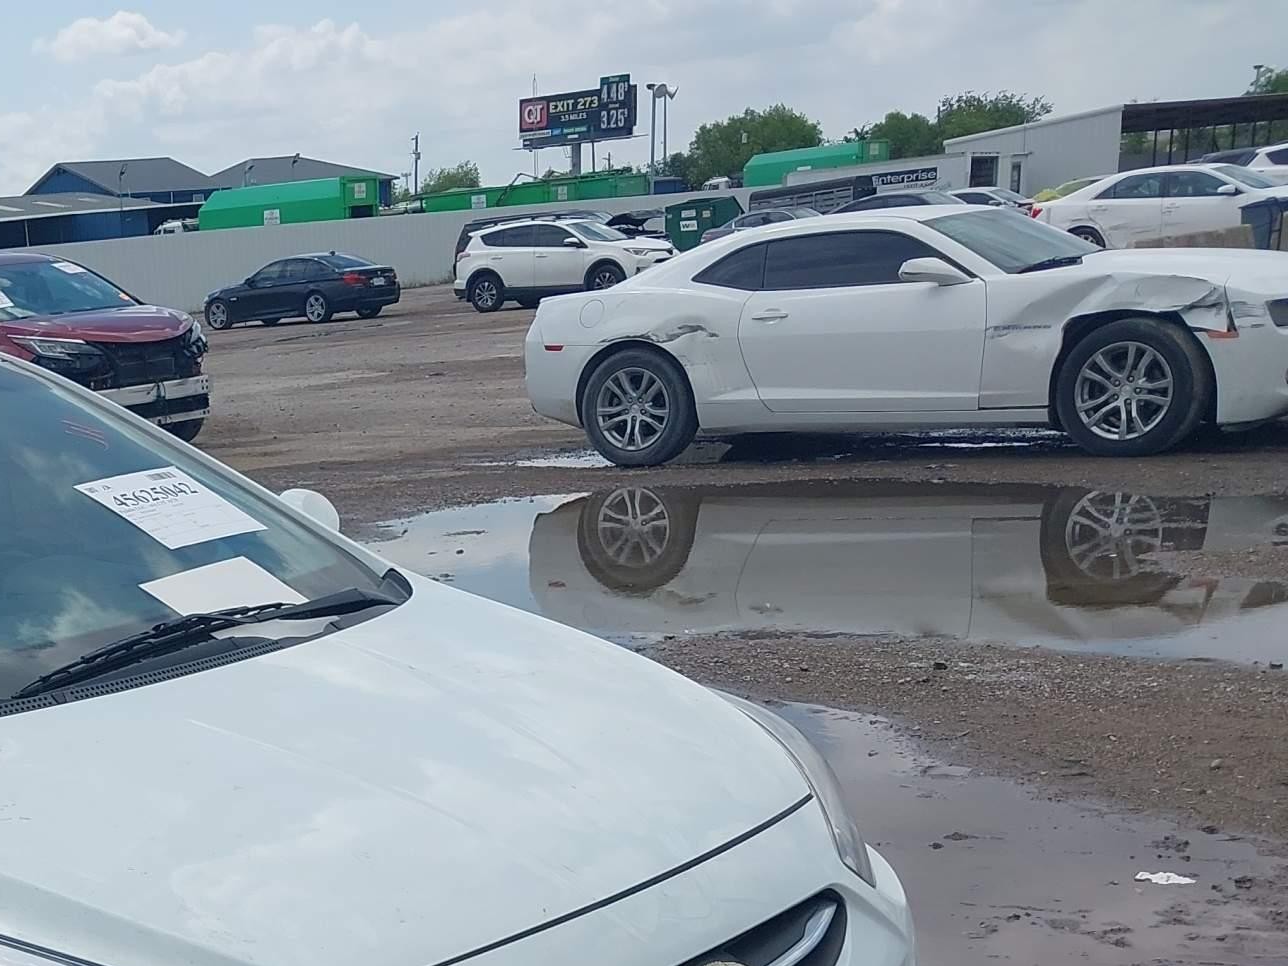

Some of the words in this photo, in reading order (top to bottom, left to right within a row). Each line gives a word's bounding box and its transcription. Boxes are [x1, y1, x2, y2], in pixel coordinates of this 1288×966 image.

[549, 100, 574, 113] EXIT
[577, 96, 599, 110] 273
[524, 104, 543, 125] QT
[872, 170, 937, 187] Enterprise
[113, 482, 199, 507] 45625042
